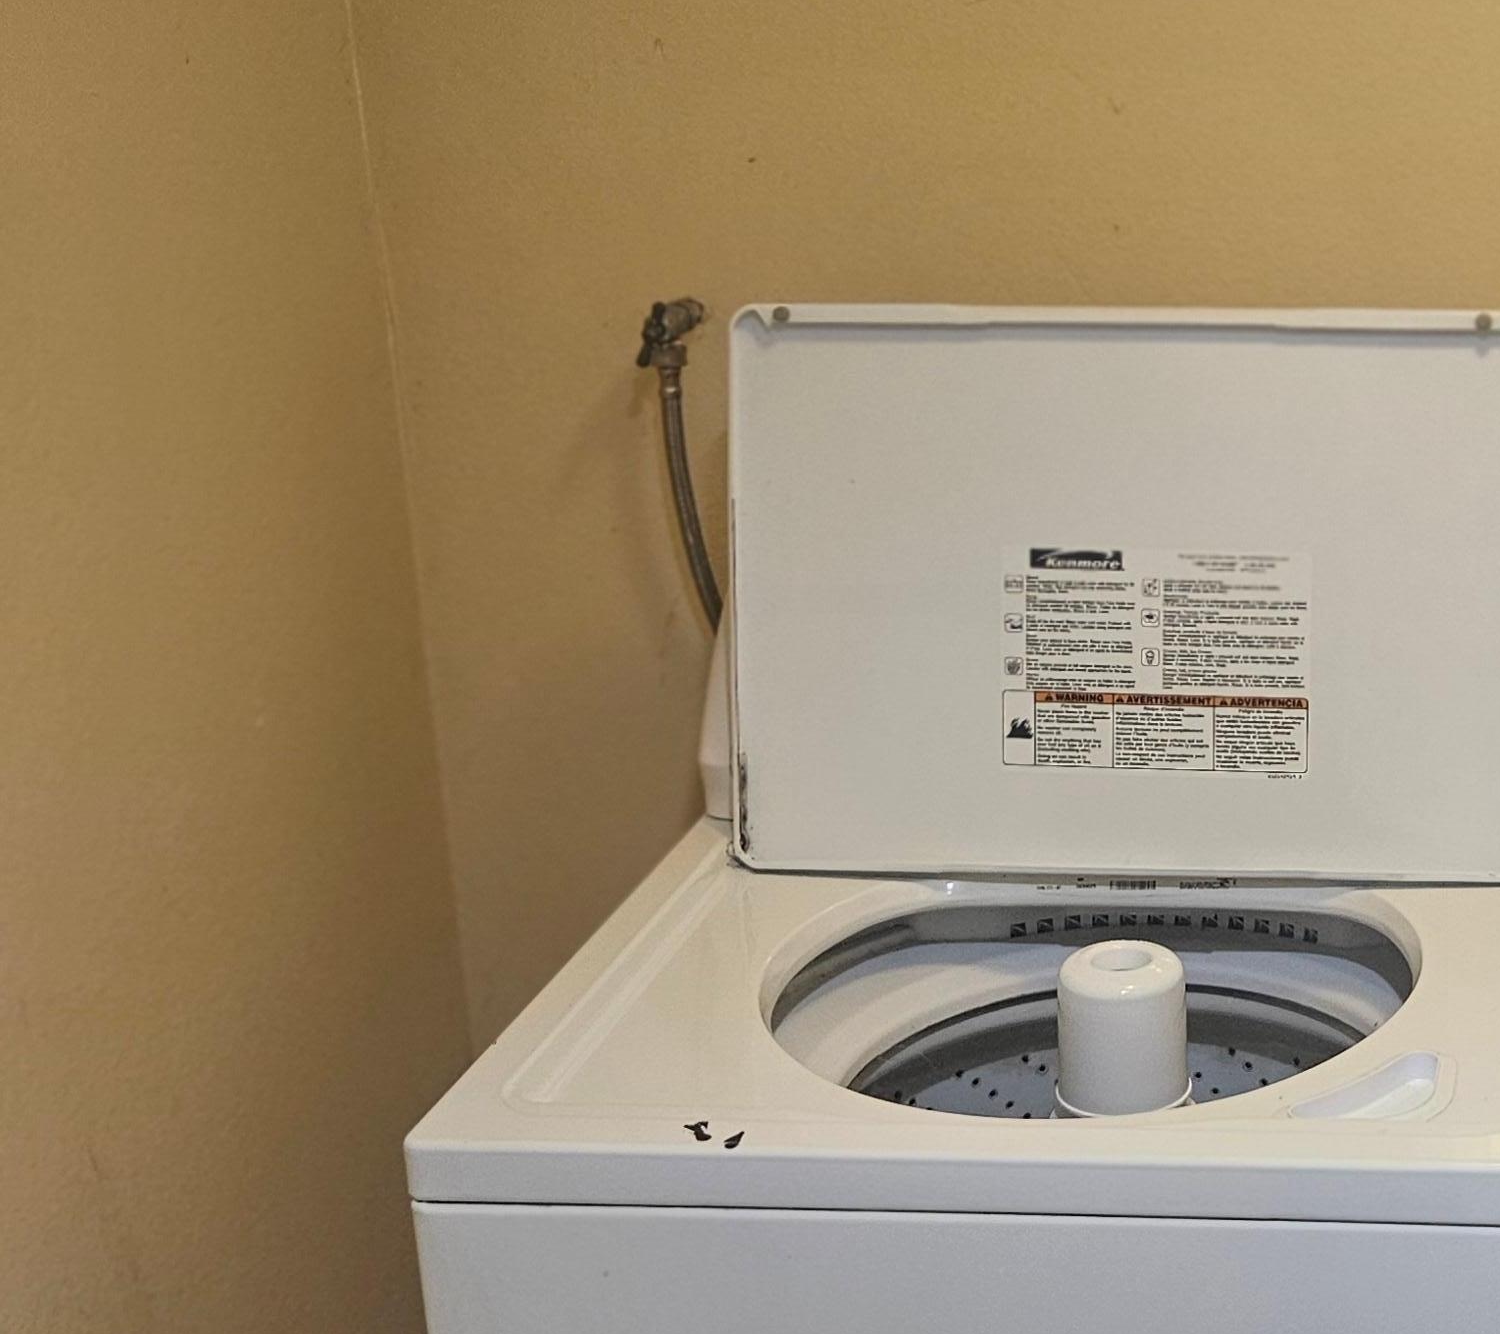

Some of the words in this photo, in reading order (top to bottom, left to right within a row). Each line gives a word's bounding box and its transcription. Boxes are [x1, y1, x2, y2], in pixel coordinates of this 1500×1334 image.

[1044, 556, 1121, 571] Kenmore
[1055, 693, 1104, 702] WARNING
[1126, 695, 1212, 705] AVERTISSEMENT
[1230, 697, 1304, 708] ADVERTENCIA
